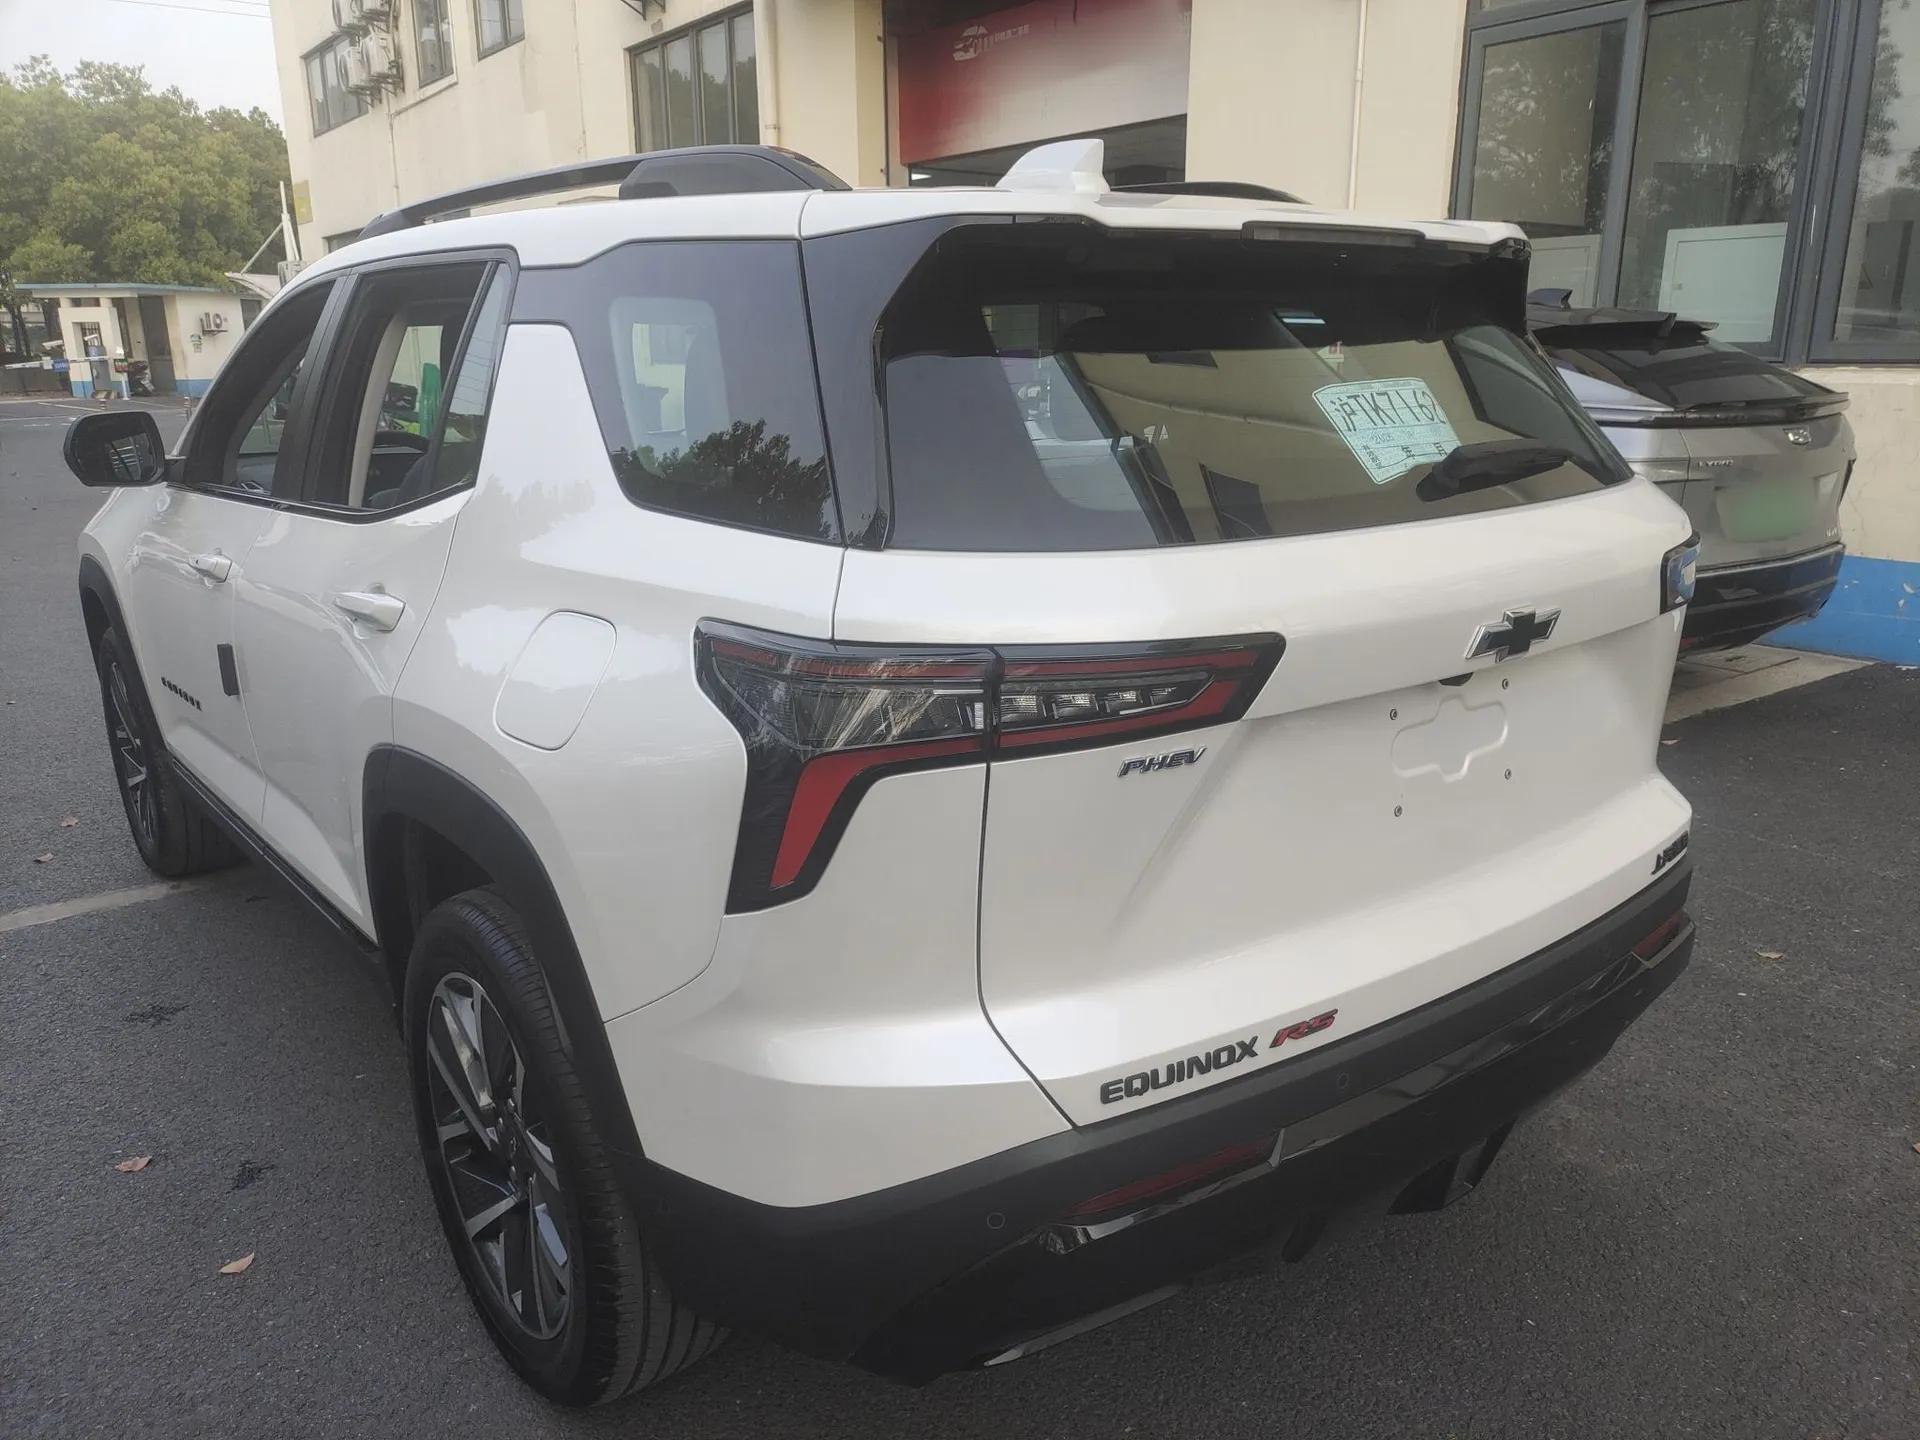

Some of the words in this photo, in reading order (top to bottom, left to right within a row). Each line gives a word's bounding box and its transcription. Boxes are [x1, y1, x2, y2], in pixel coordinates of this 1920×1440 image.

[1117, 746, 1207, 777] PHEV
[1100, 1036, 1258, 1105] EQUINOX
[1269, 1008, 1339, 1048] RS
